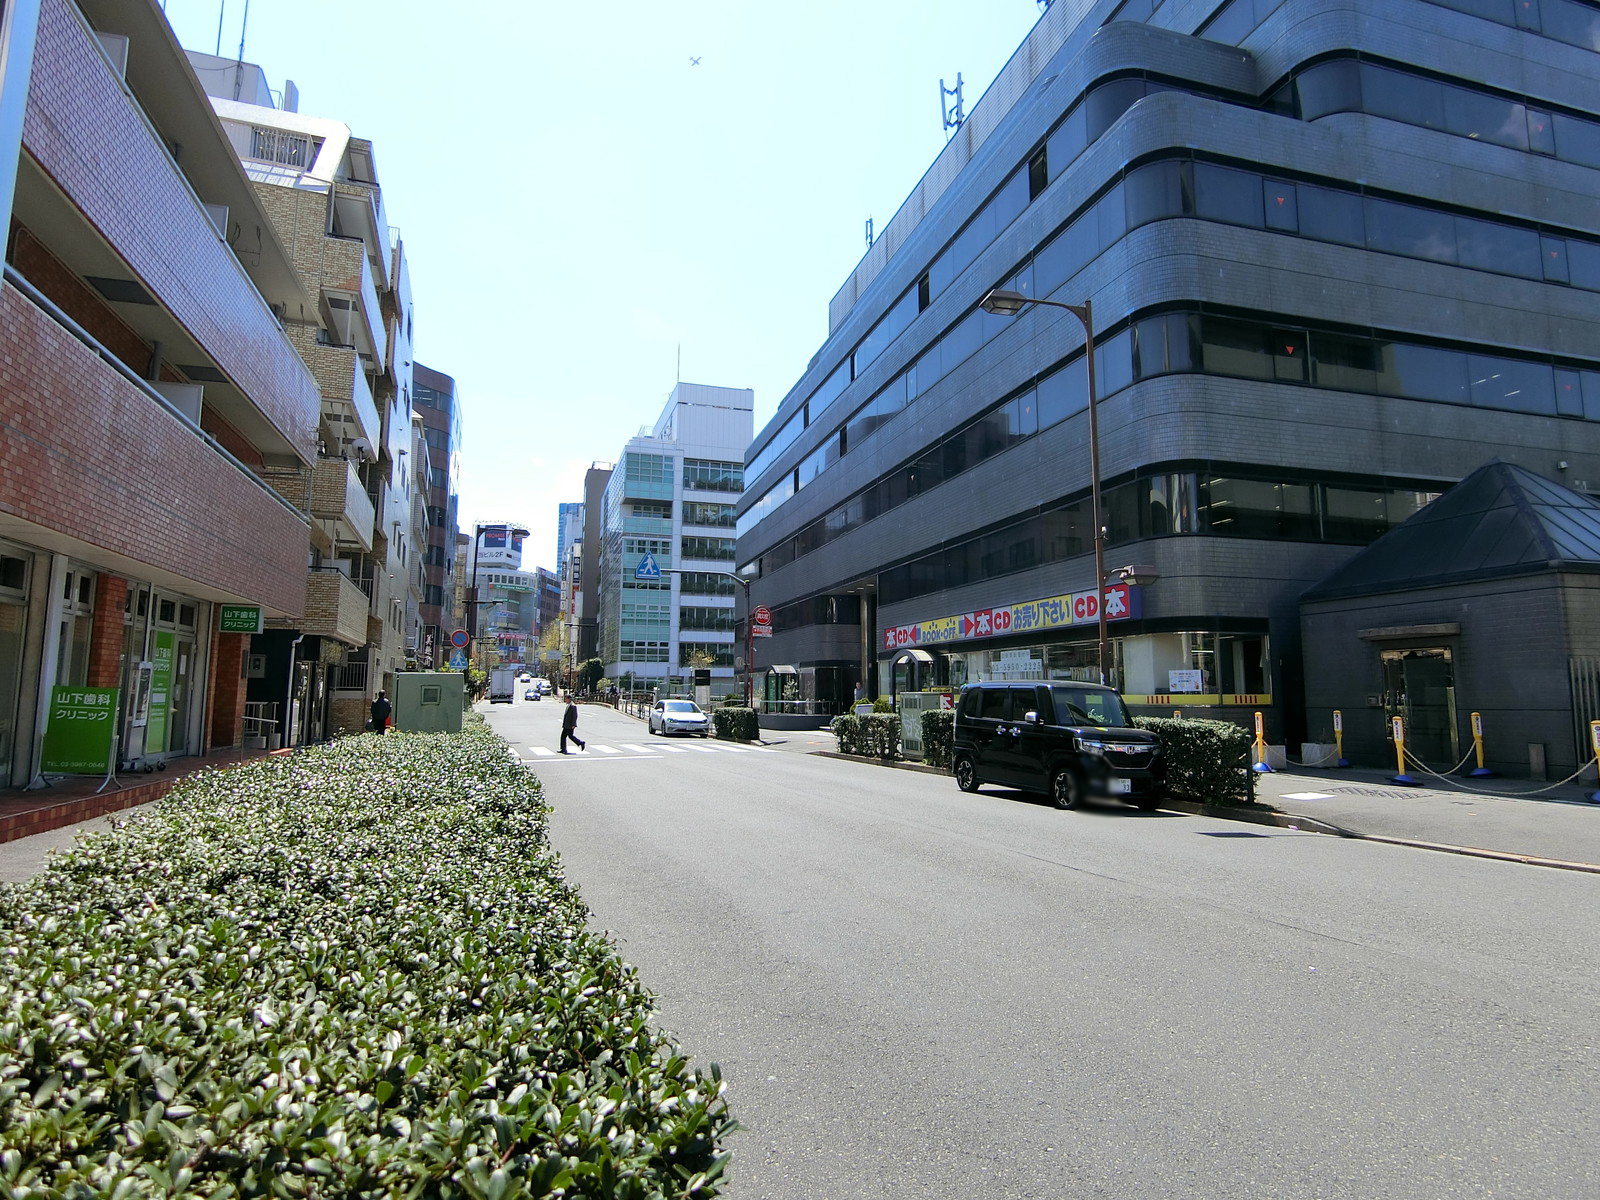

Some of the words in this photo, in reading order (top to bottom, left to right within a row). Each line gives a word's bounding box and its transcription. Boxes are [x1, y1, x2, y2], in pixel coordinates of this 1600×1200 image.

[224, 610, 257, 619] 山下歯科
[897, 629, 908, 644] CD
[976, 612, 991, 635] 本
[993, 611, 1011, 630] CD
[1013, 599, 1070, 630] お売り下さい
[1074, 595, 1098, 618] CD
[1105, 588, 1125, 616] 本
[224, 621, 256, 629] クリニック
[57, 692, 111, 706] 山下歯科
[56, 709, 109, 721] クリニック
